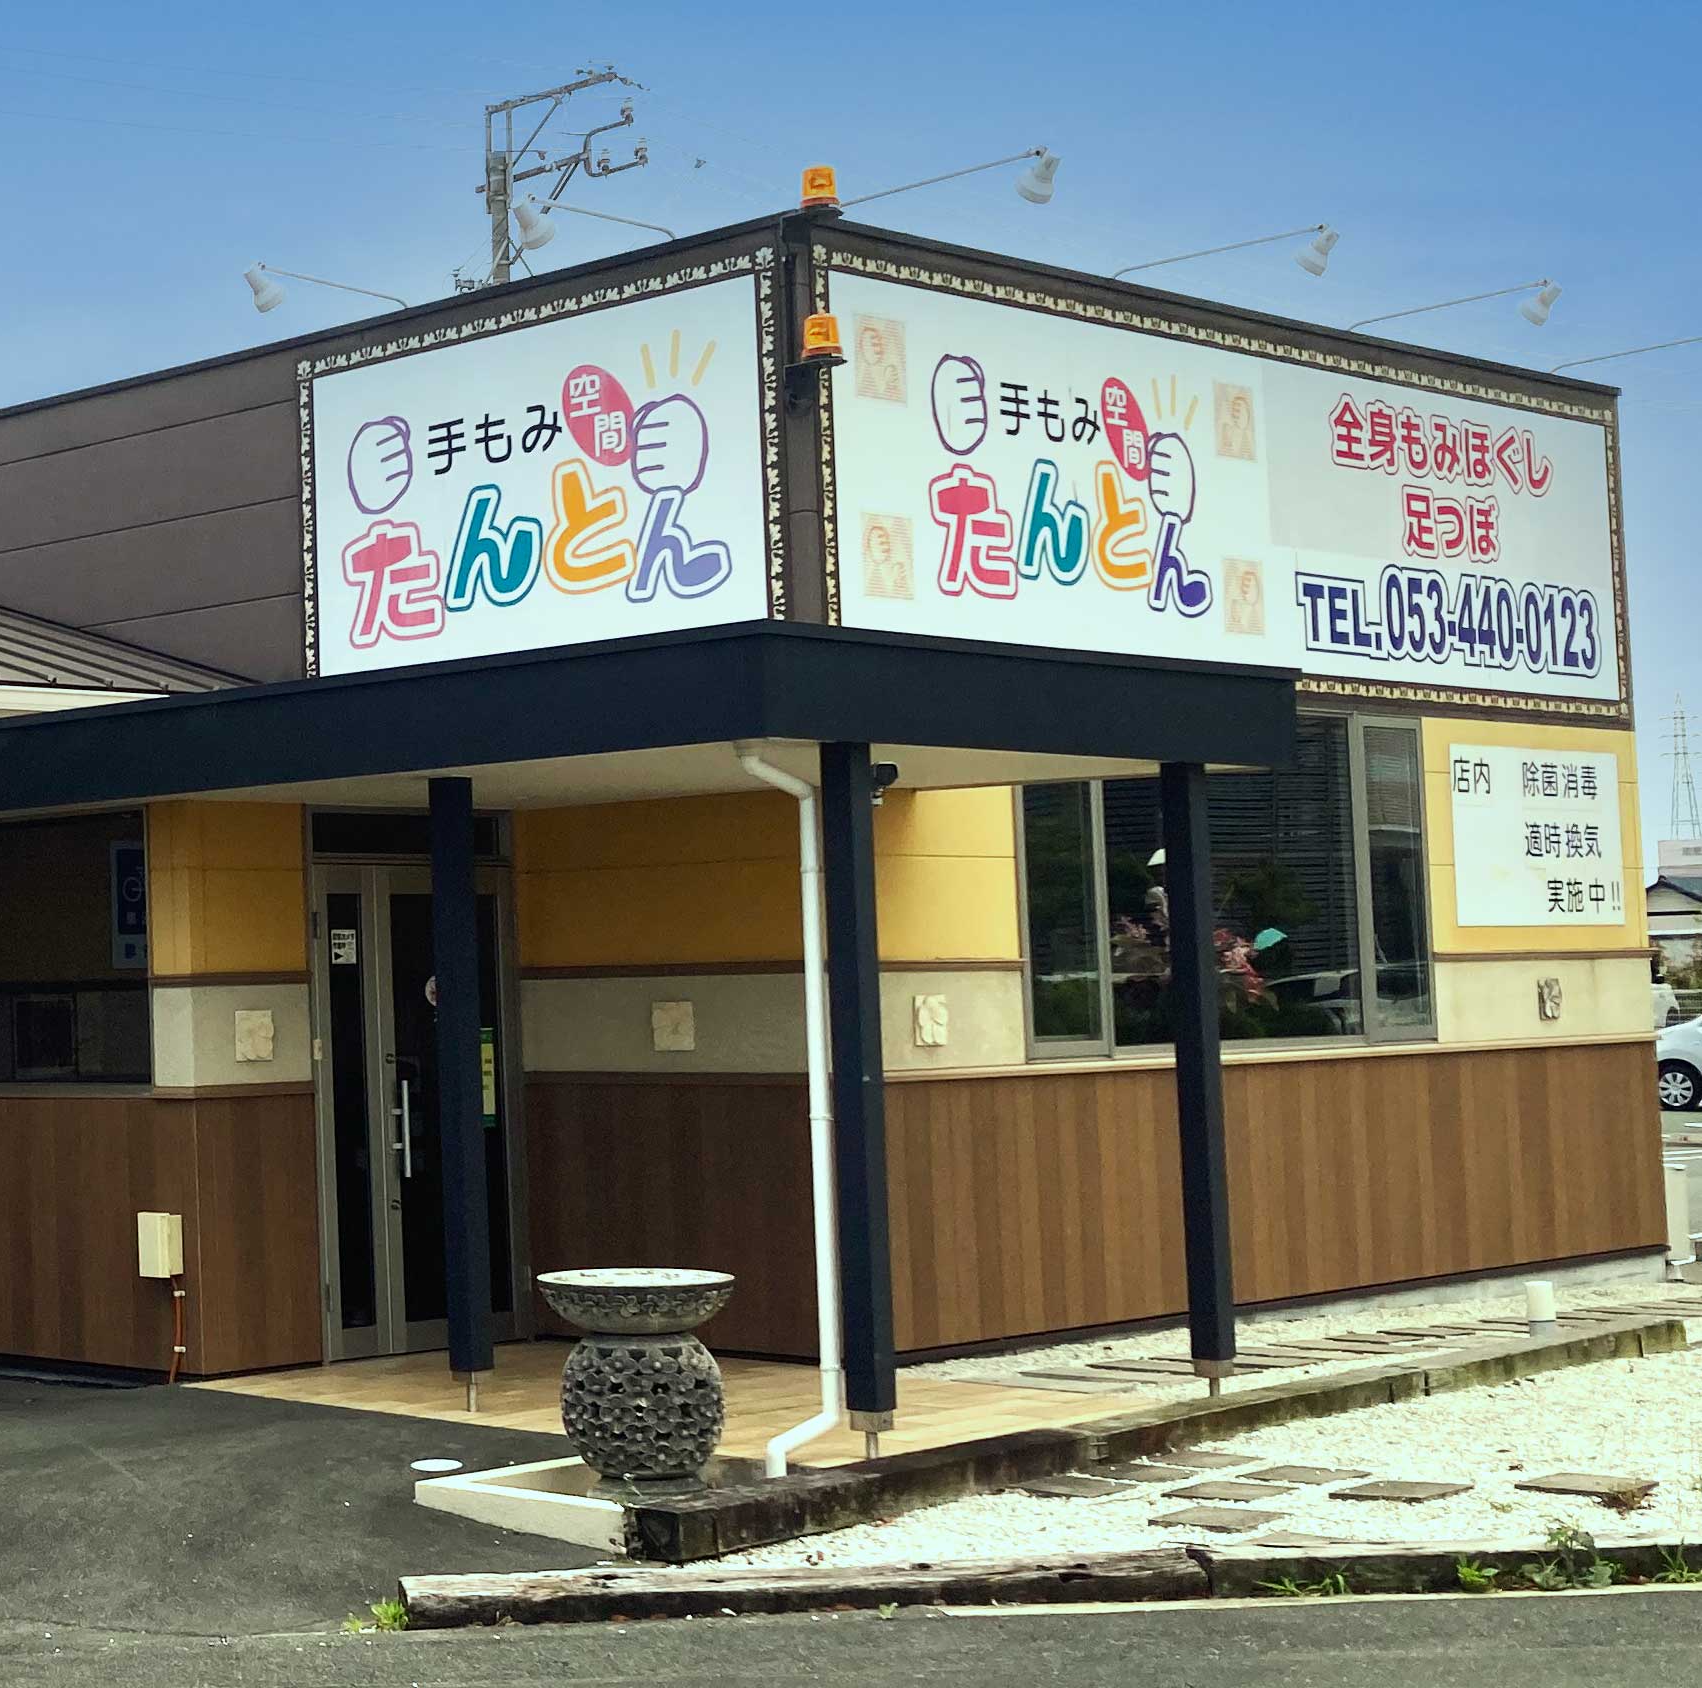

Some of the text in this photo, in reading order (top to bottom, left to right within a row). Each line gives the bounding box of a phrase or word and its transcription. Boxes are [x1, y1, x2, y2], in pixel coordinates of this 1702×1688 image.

[427, 373, 627, 476] 手もみ 空間
[999, 382, 1146, 470] 手もみ 空間
[1331, 397, 1551, 493] 全身もみほぐし
[342, 458, 732, 649] たんとん
[929, 458, 1212, 618] たんとん
[1404, 489, 1498, 559] 足つぼ
[1299, 568, 1599, 674] TEL.053-440-0123
[1452, 755, 1598, 800] 店内 除菌消毒
[1524, 821, 1602, 859] 適時換気
